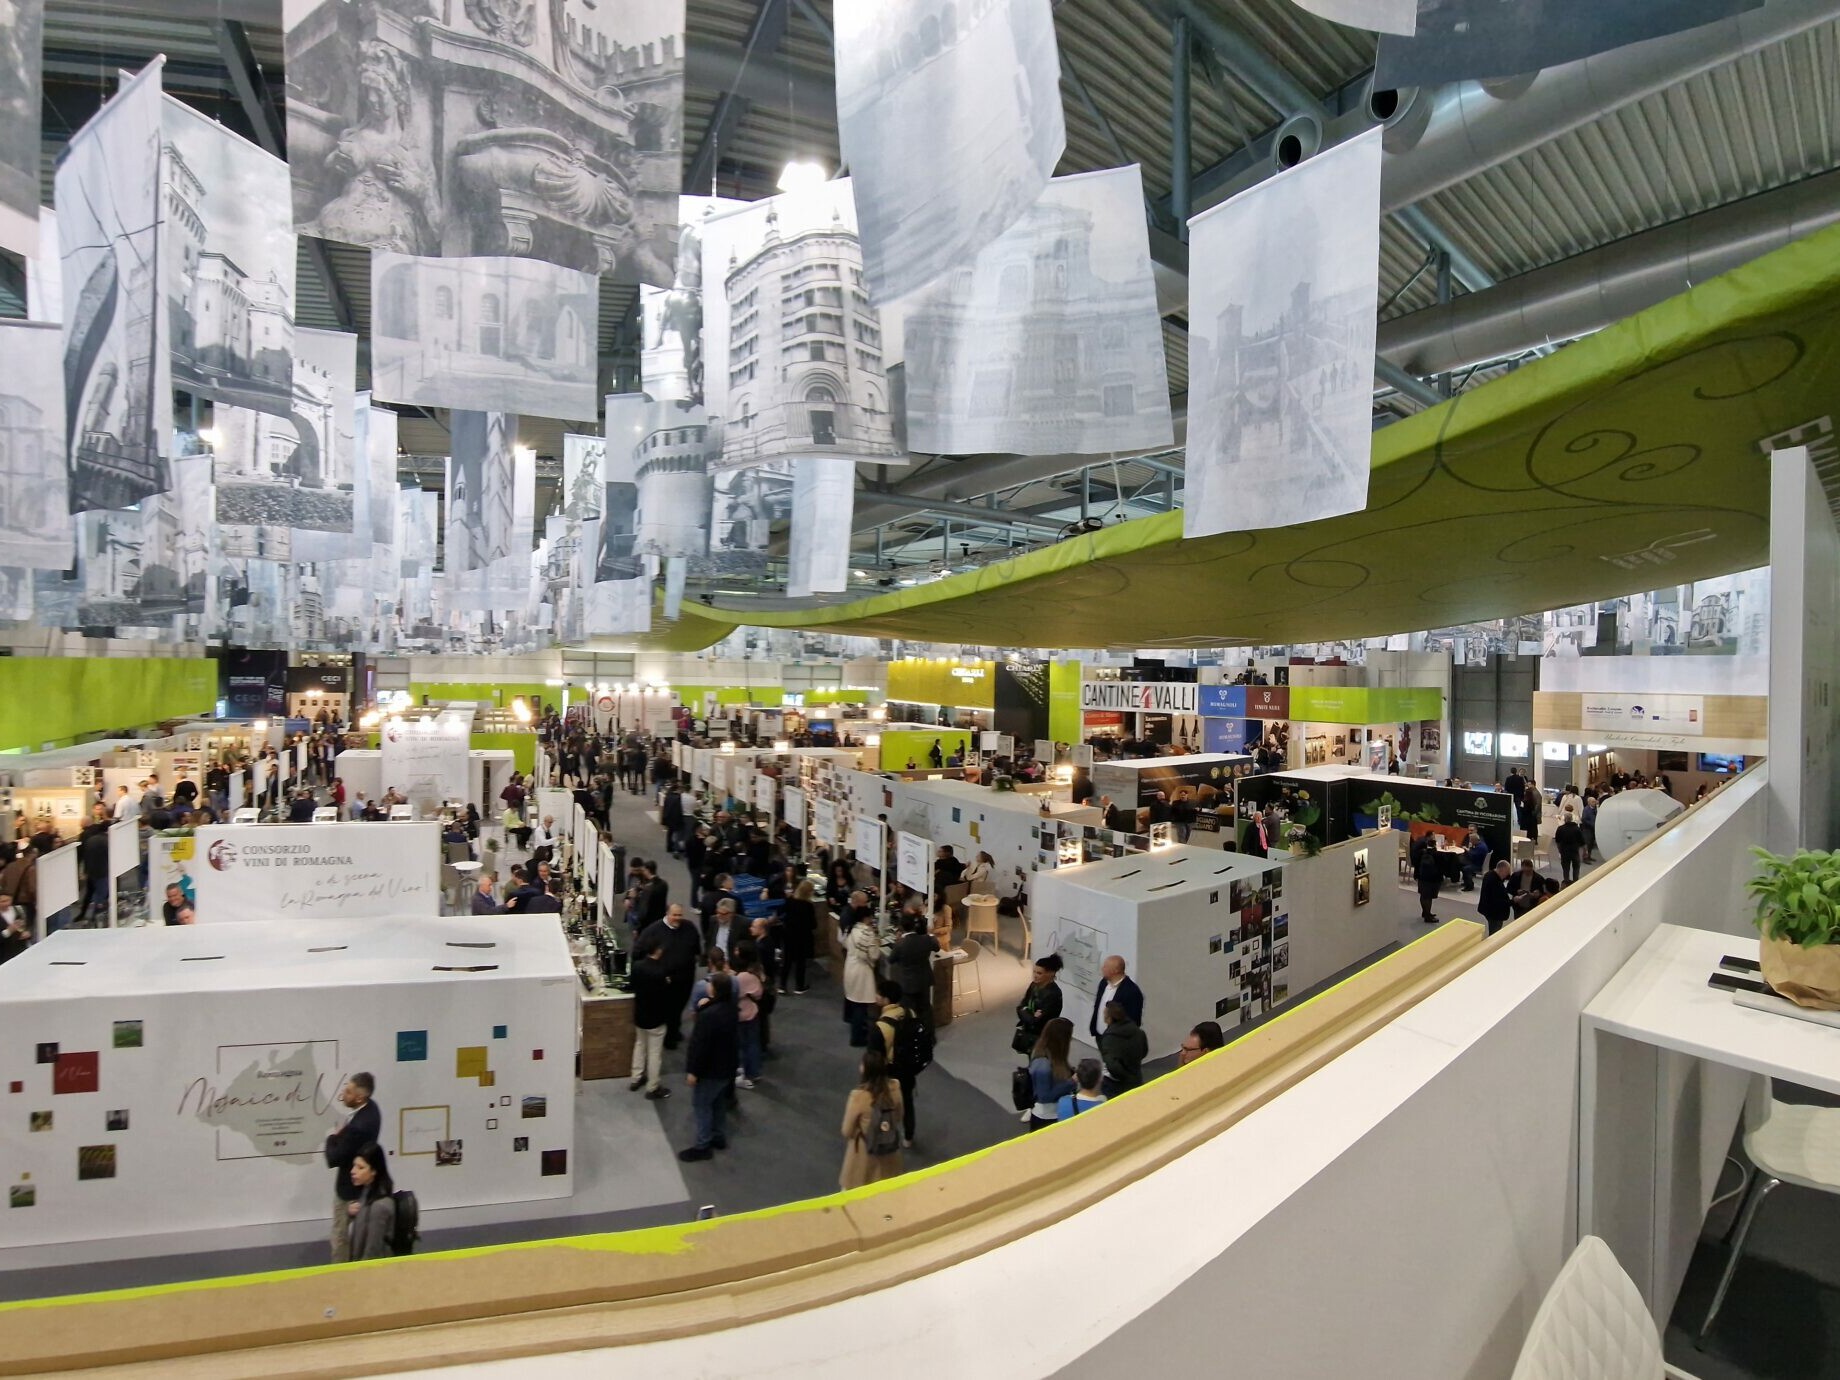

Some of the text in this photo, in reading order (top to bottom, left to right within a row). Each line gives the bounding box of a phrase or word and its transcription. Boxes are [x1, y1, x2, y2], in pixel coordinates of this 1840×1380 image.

[1084, 684, 1141, 708] CANTINE
[1154, 686, 1196, 712] VALLI
[242, 844, 312, 855] CONSORZIO
[243, 856, 354, 867] VINI DI ROMAGNA
[177, 1076, 281, 1118] Mosaico
